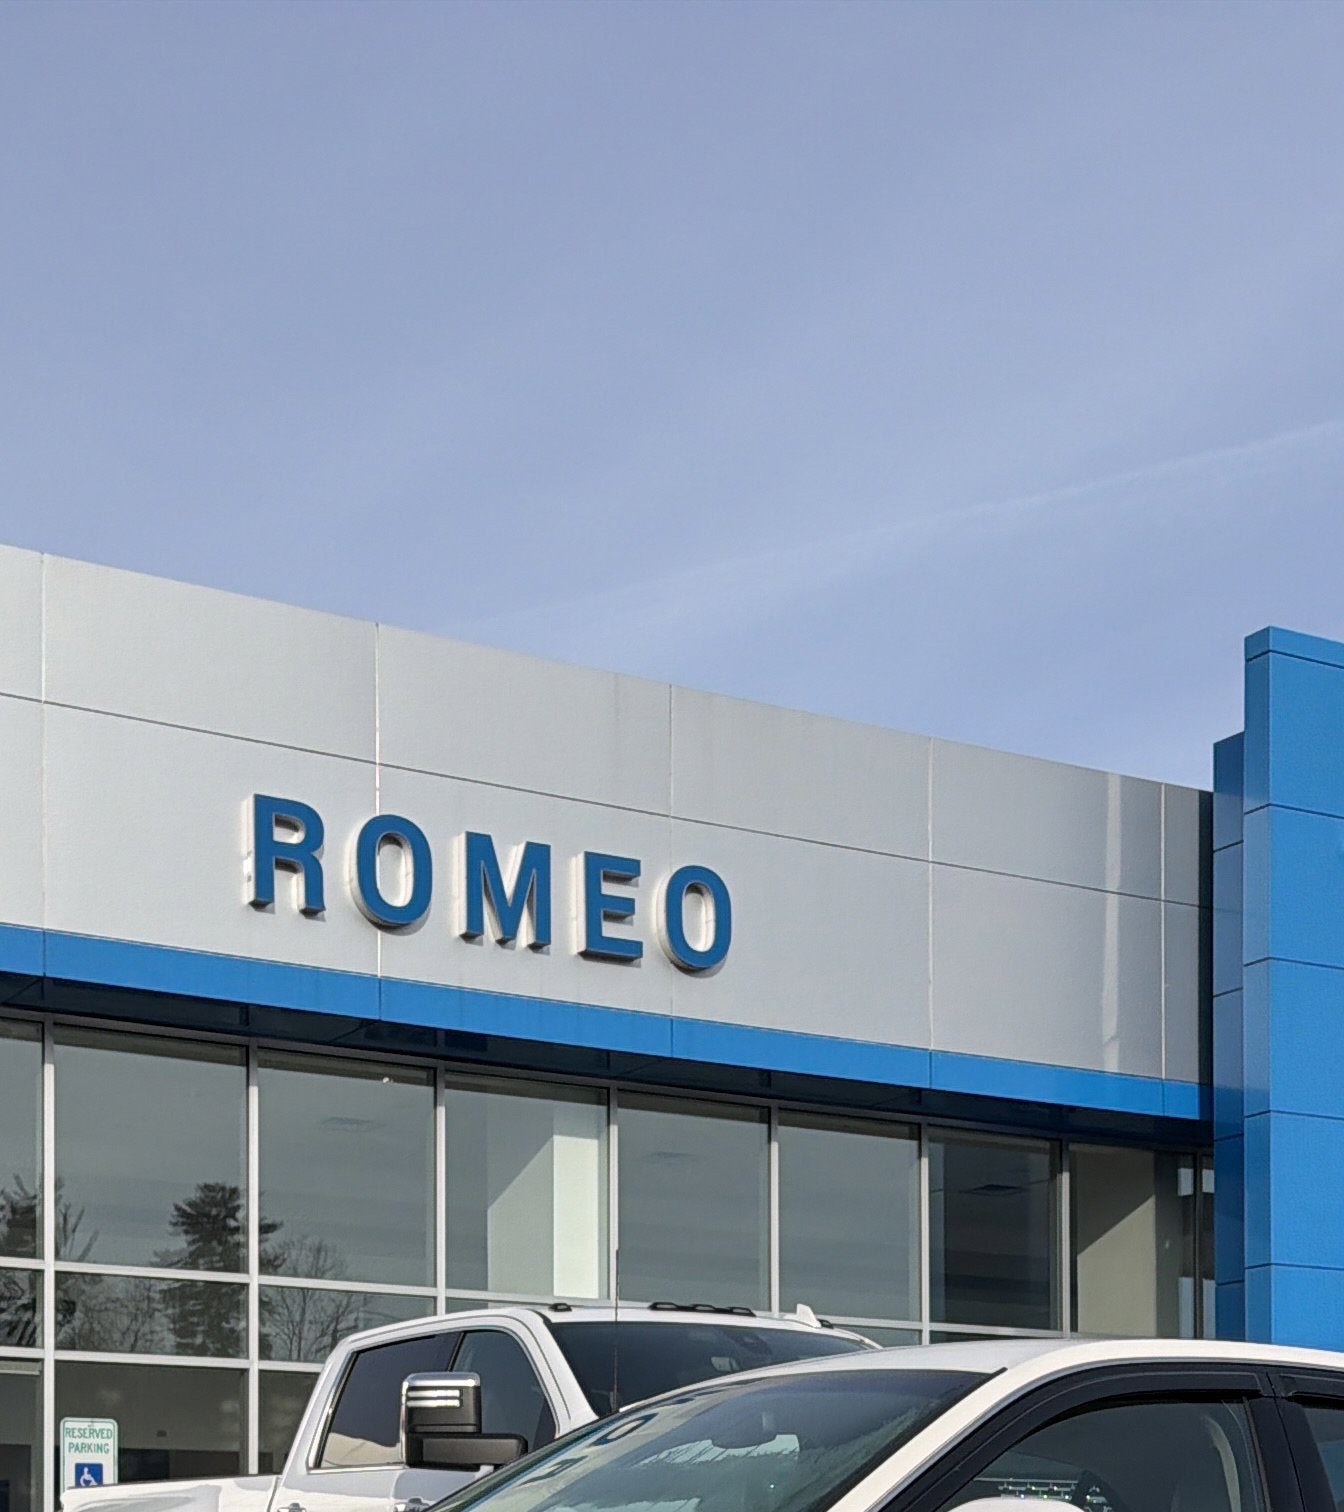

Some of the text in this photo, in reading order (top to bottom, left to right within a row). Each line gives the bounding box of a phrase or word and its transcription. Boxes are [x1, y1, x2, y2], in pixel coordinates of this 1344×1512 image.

[248, 793, 732, 970] ROMEO
[65, 1427, 113, 1440] RESERVED
[68, 1442, 110, 1455] PARKING
